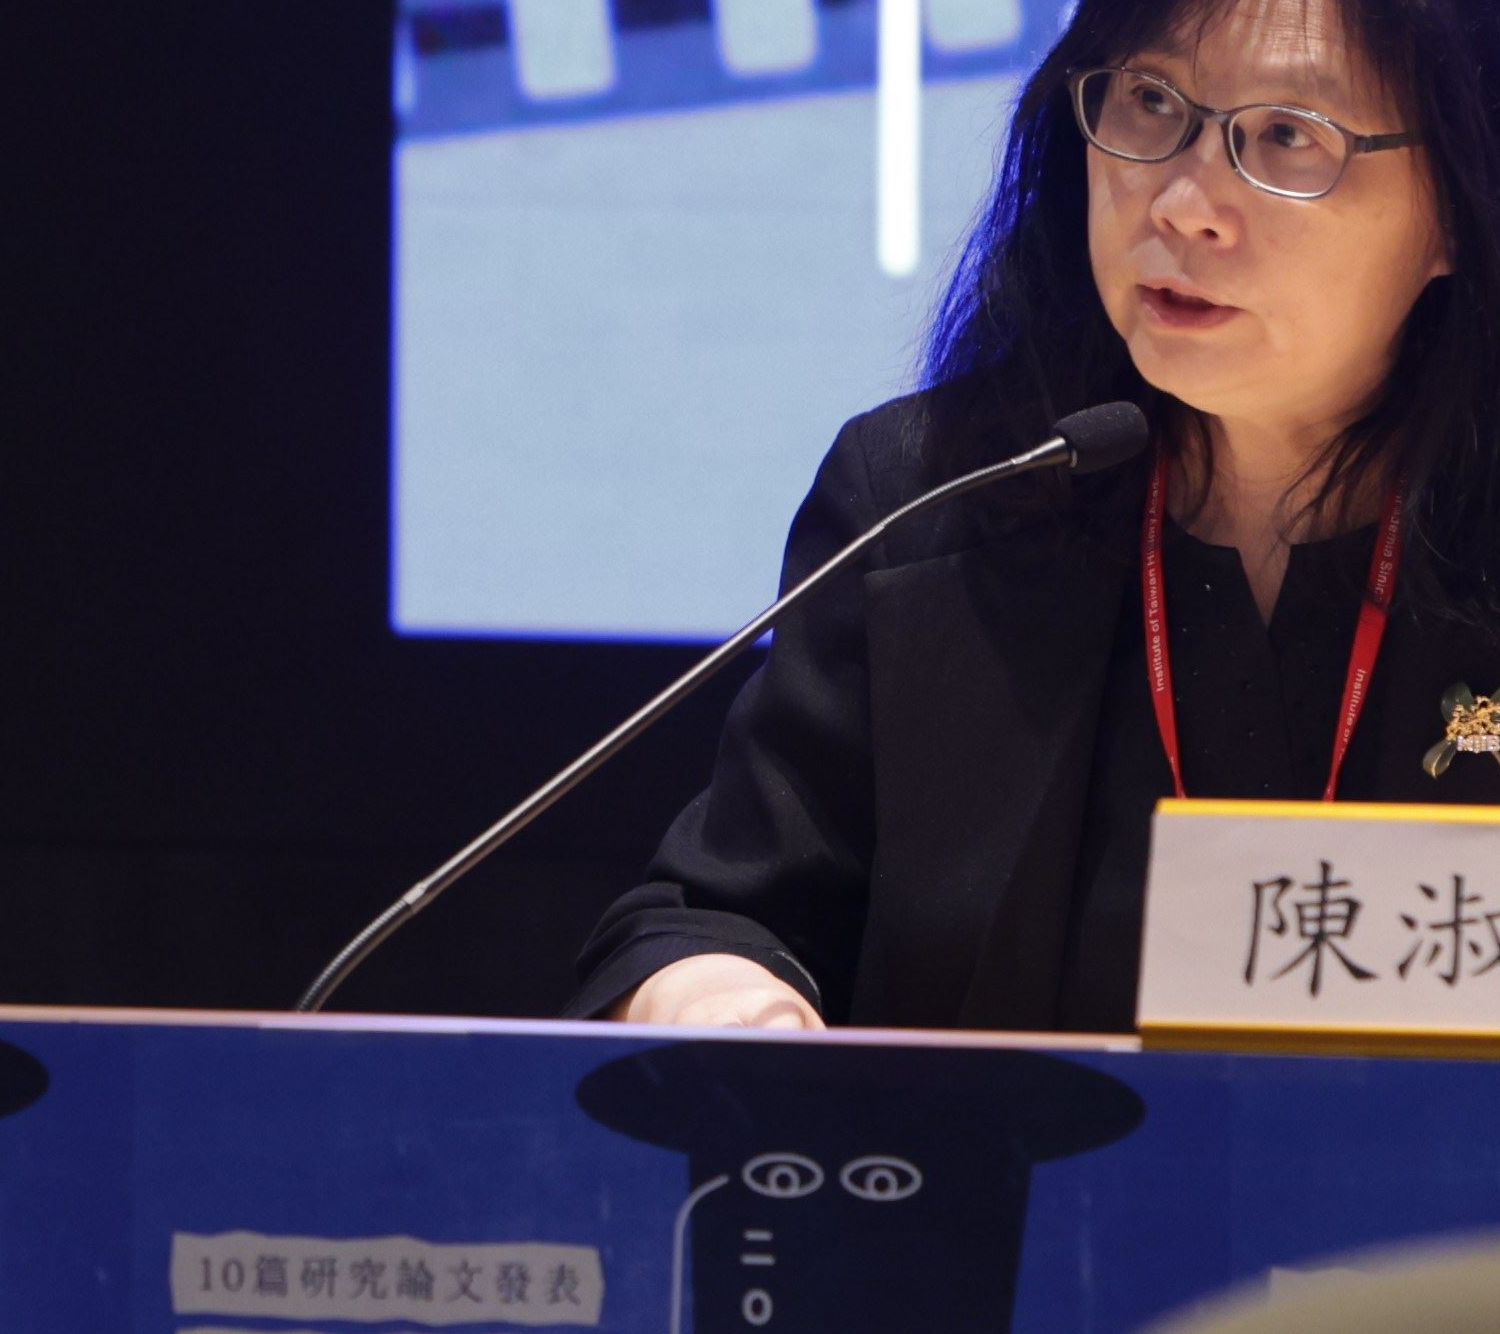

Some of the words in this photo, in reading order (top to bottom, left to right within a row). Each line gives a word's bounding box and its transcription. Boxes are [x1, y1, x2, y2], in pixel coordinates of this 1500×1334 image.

[1150, 618, 1161, 634] of
[1153, 634, 1166, 693] Institute
[199, 1252, 584, 1307] 10篇研究論文發表
